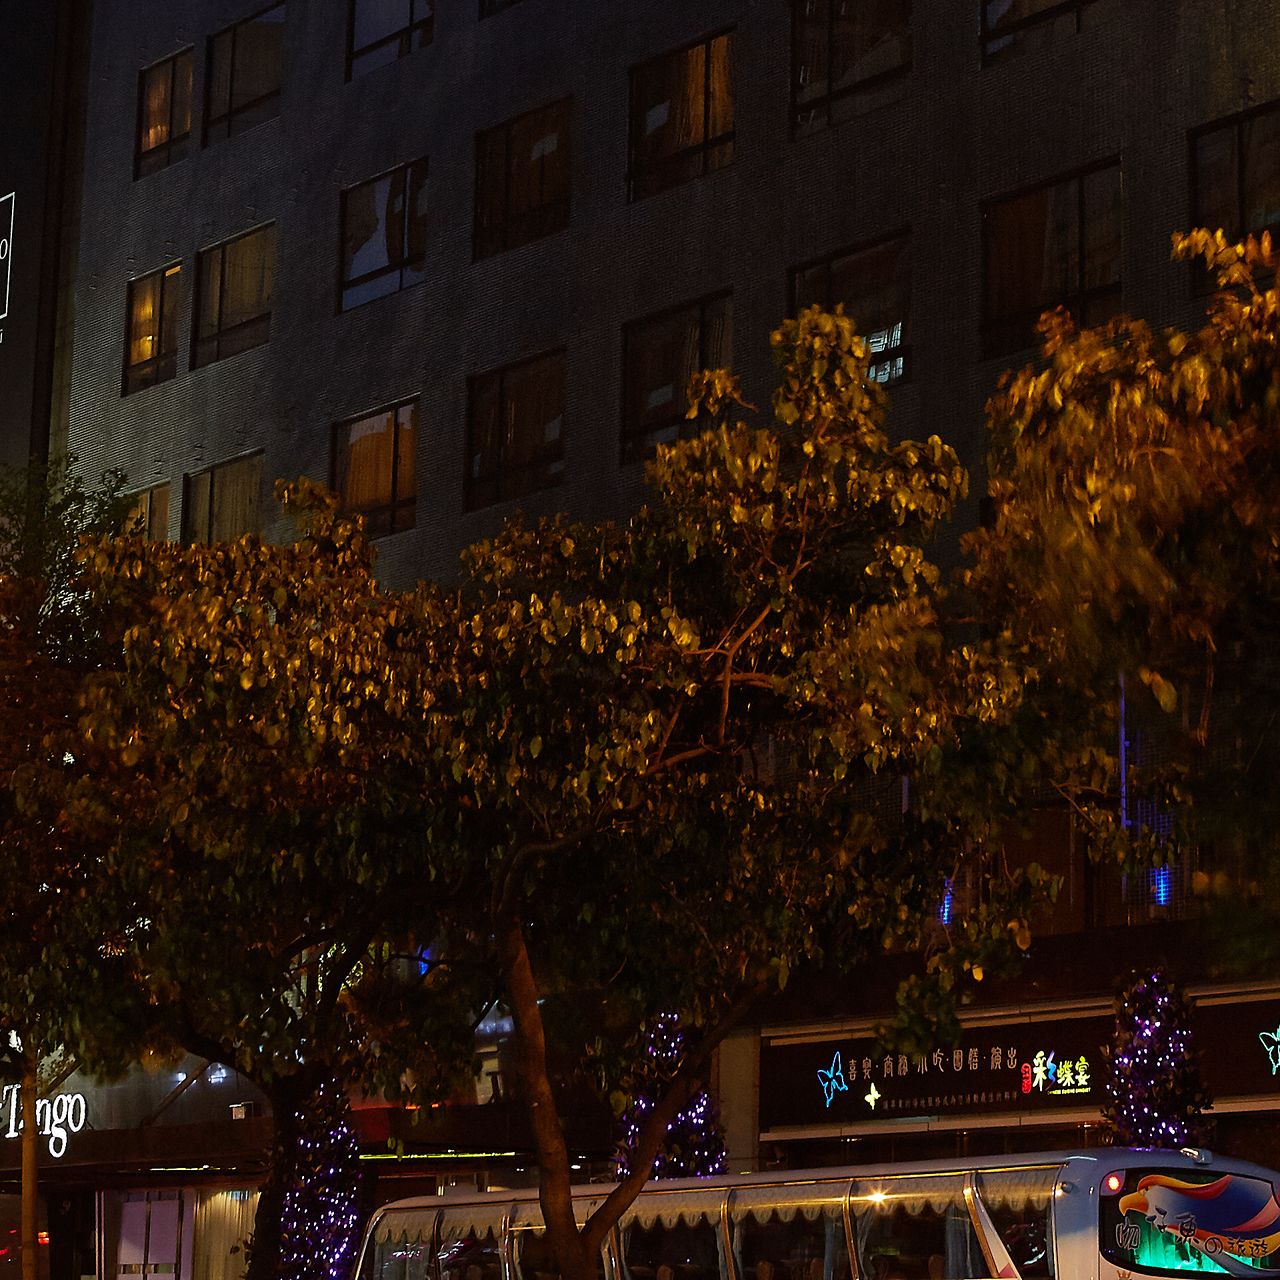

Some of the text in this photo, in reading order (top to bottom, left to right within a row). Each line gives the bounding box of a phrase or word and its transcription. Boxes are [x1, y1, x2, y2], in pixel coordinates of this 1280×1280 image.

[1032, 1050, 1090, 1092] 彩蝶宴
[3, 1083, 87, 1158] Tngo
